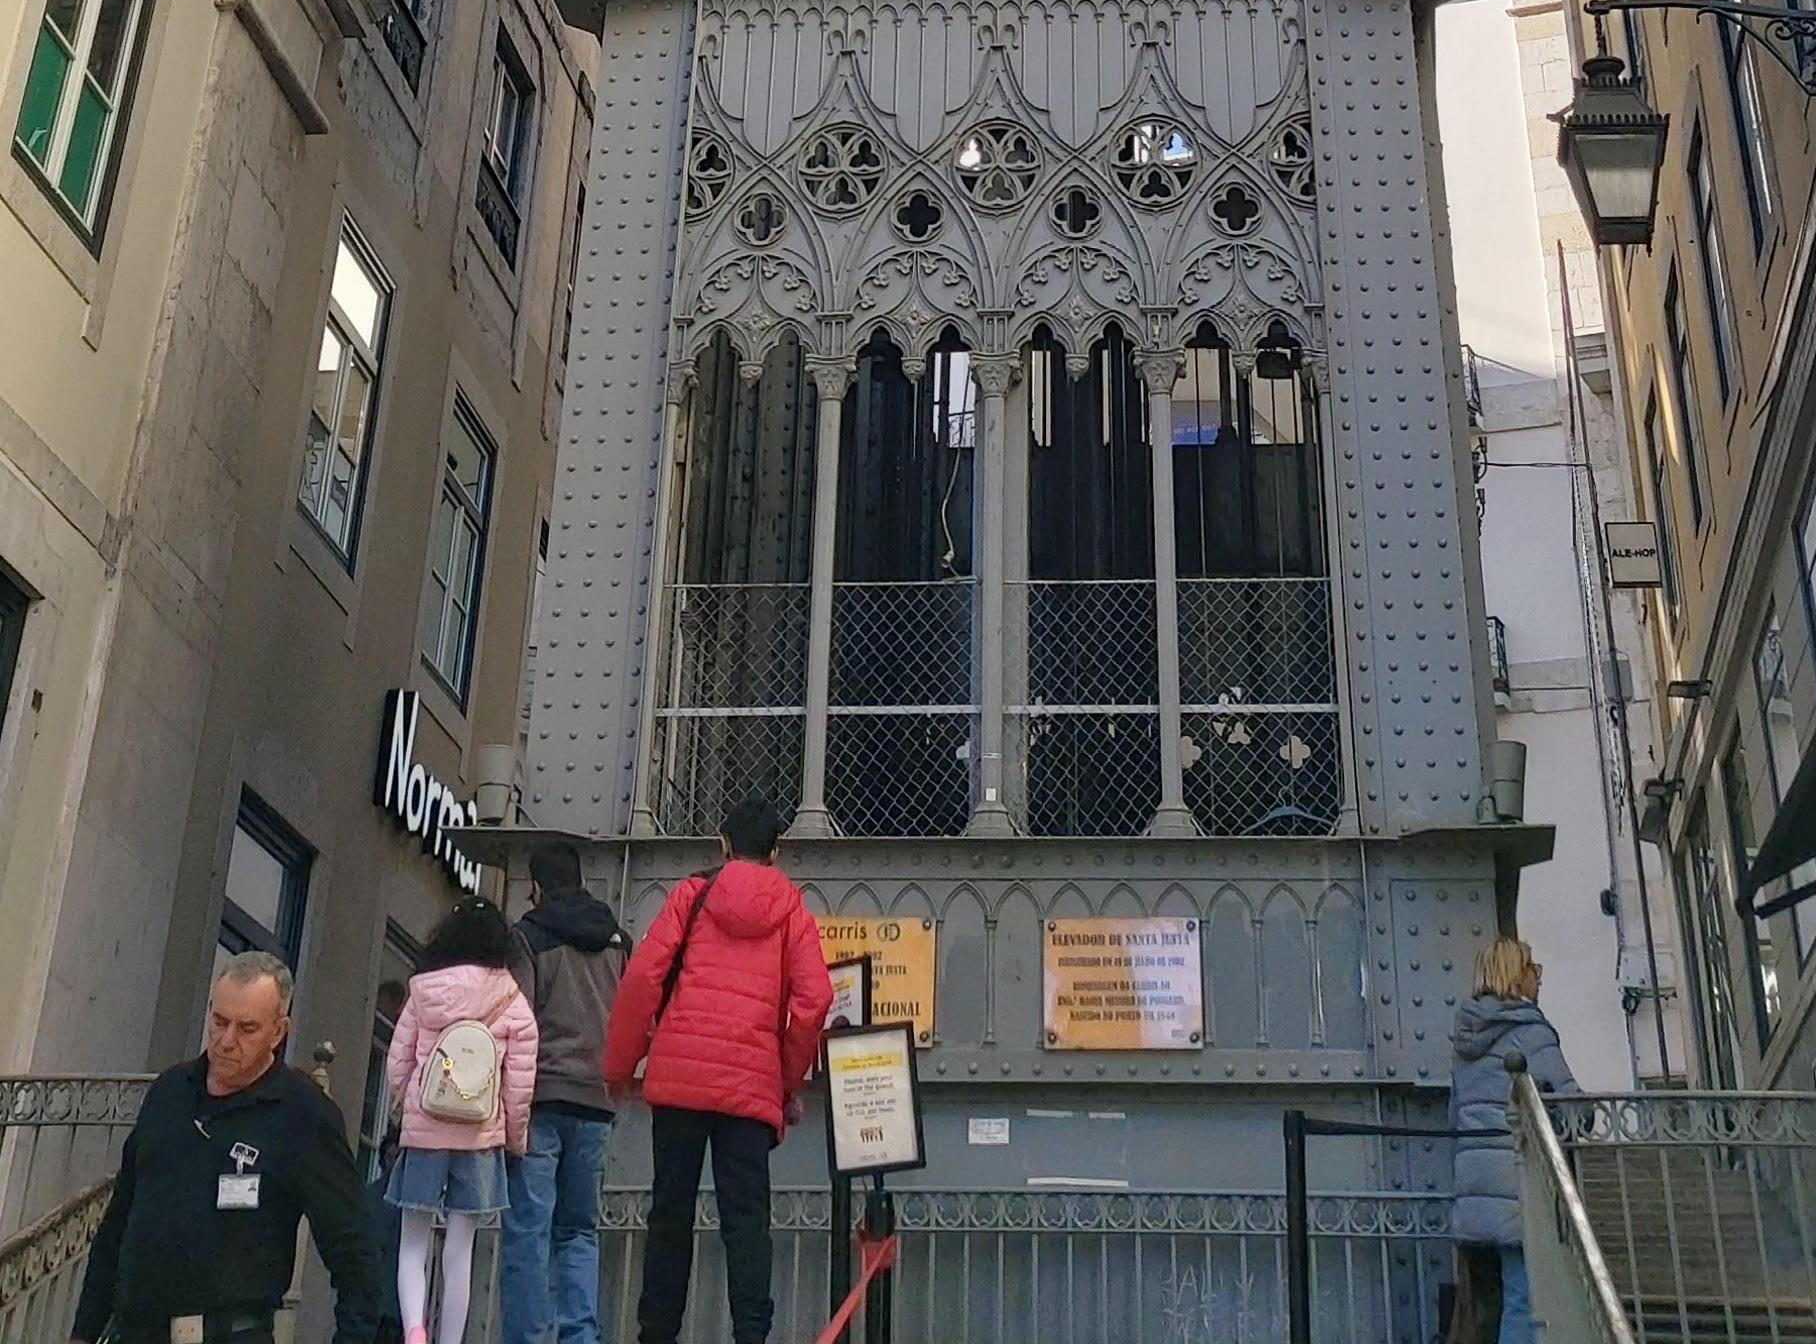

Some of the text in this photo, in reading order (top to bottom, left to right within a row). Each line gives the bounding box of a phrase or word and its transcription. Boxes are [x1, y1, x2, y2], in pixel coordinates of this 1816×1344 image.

[1612, 548, 1656, 558] ALE-HOP
[818, 922, 867, 940] carris
[1126, 933, 1158, 946] SANTA
[1161, 933, 1190, 947] JUSTA
